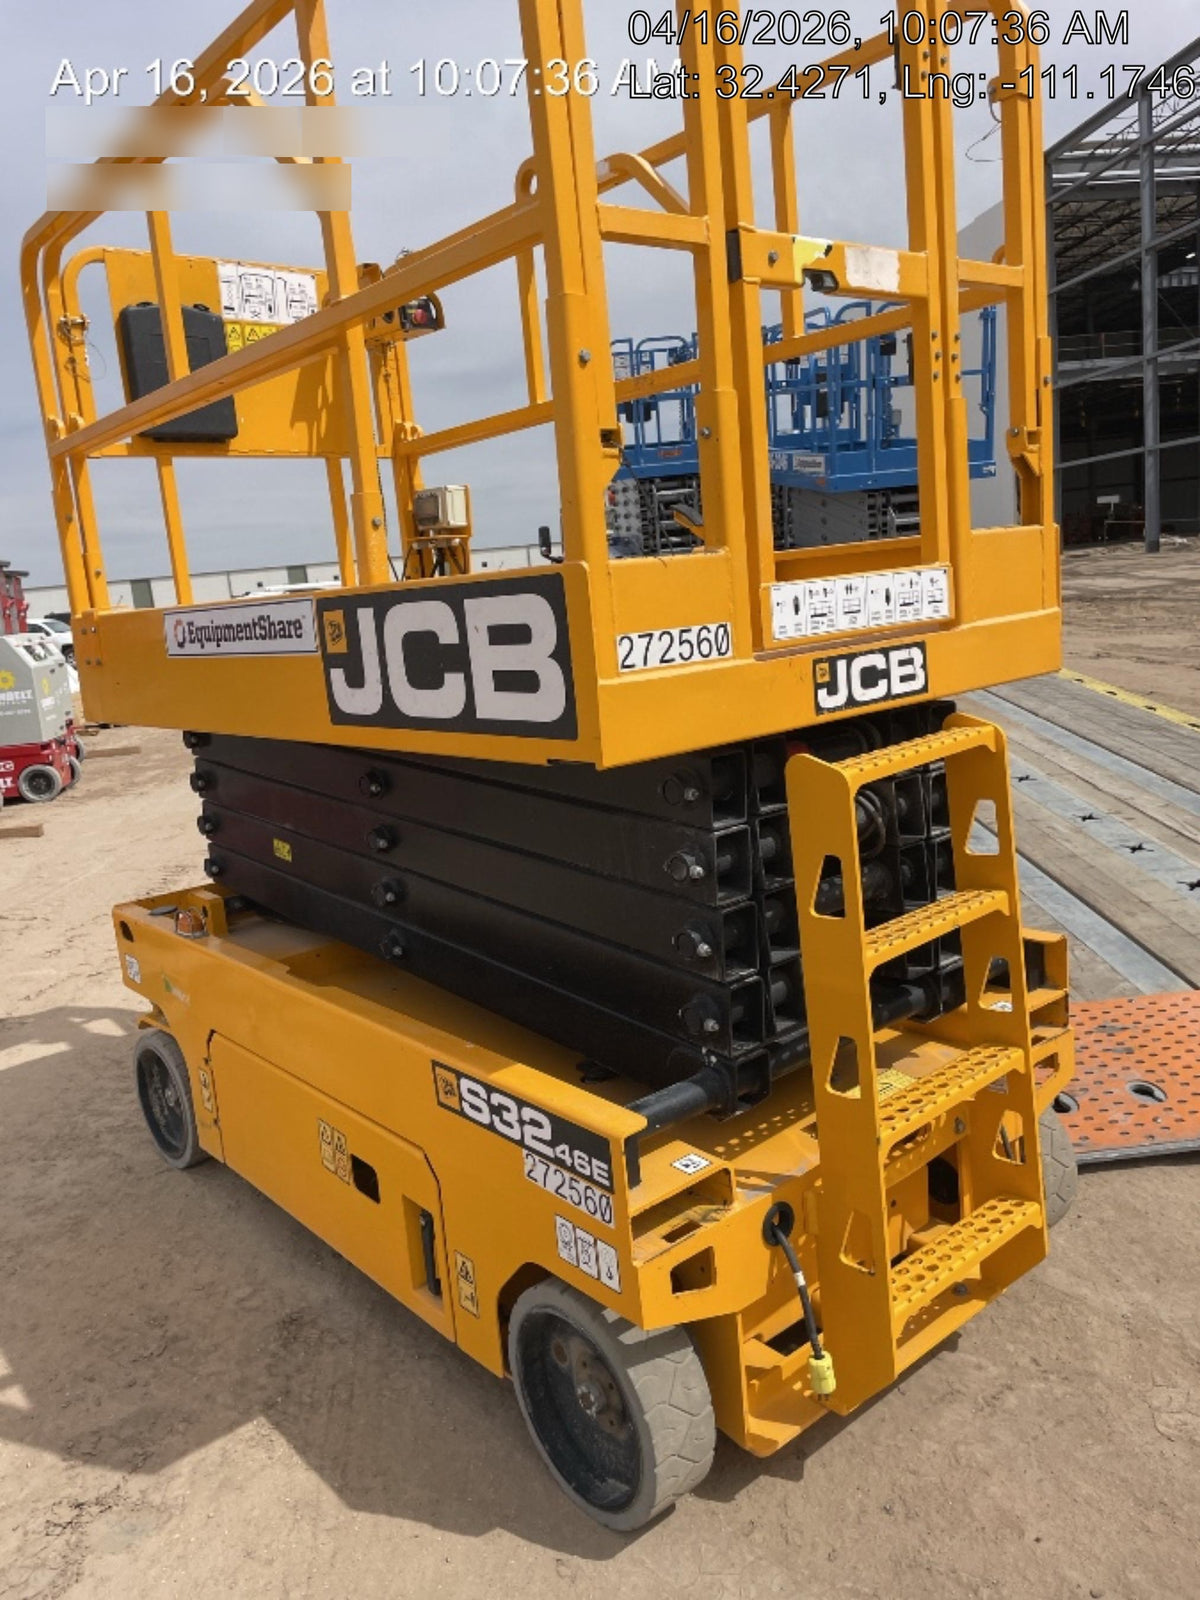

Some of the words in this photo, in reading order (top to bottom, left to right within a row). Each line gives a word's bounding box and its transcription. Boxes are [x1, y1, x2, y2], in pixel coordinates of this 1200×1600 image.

[186, 615, 303, 649] EquipmentShare
[329, 593, 567, 724] JCB
[618, 624, 731, 670] 272560
[817, 647, 925, 709] JCB
[526, 1153, 612, 1225] 272560
